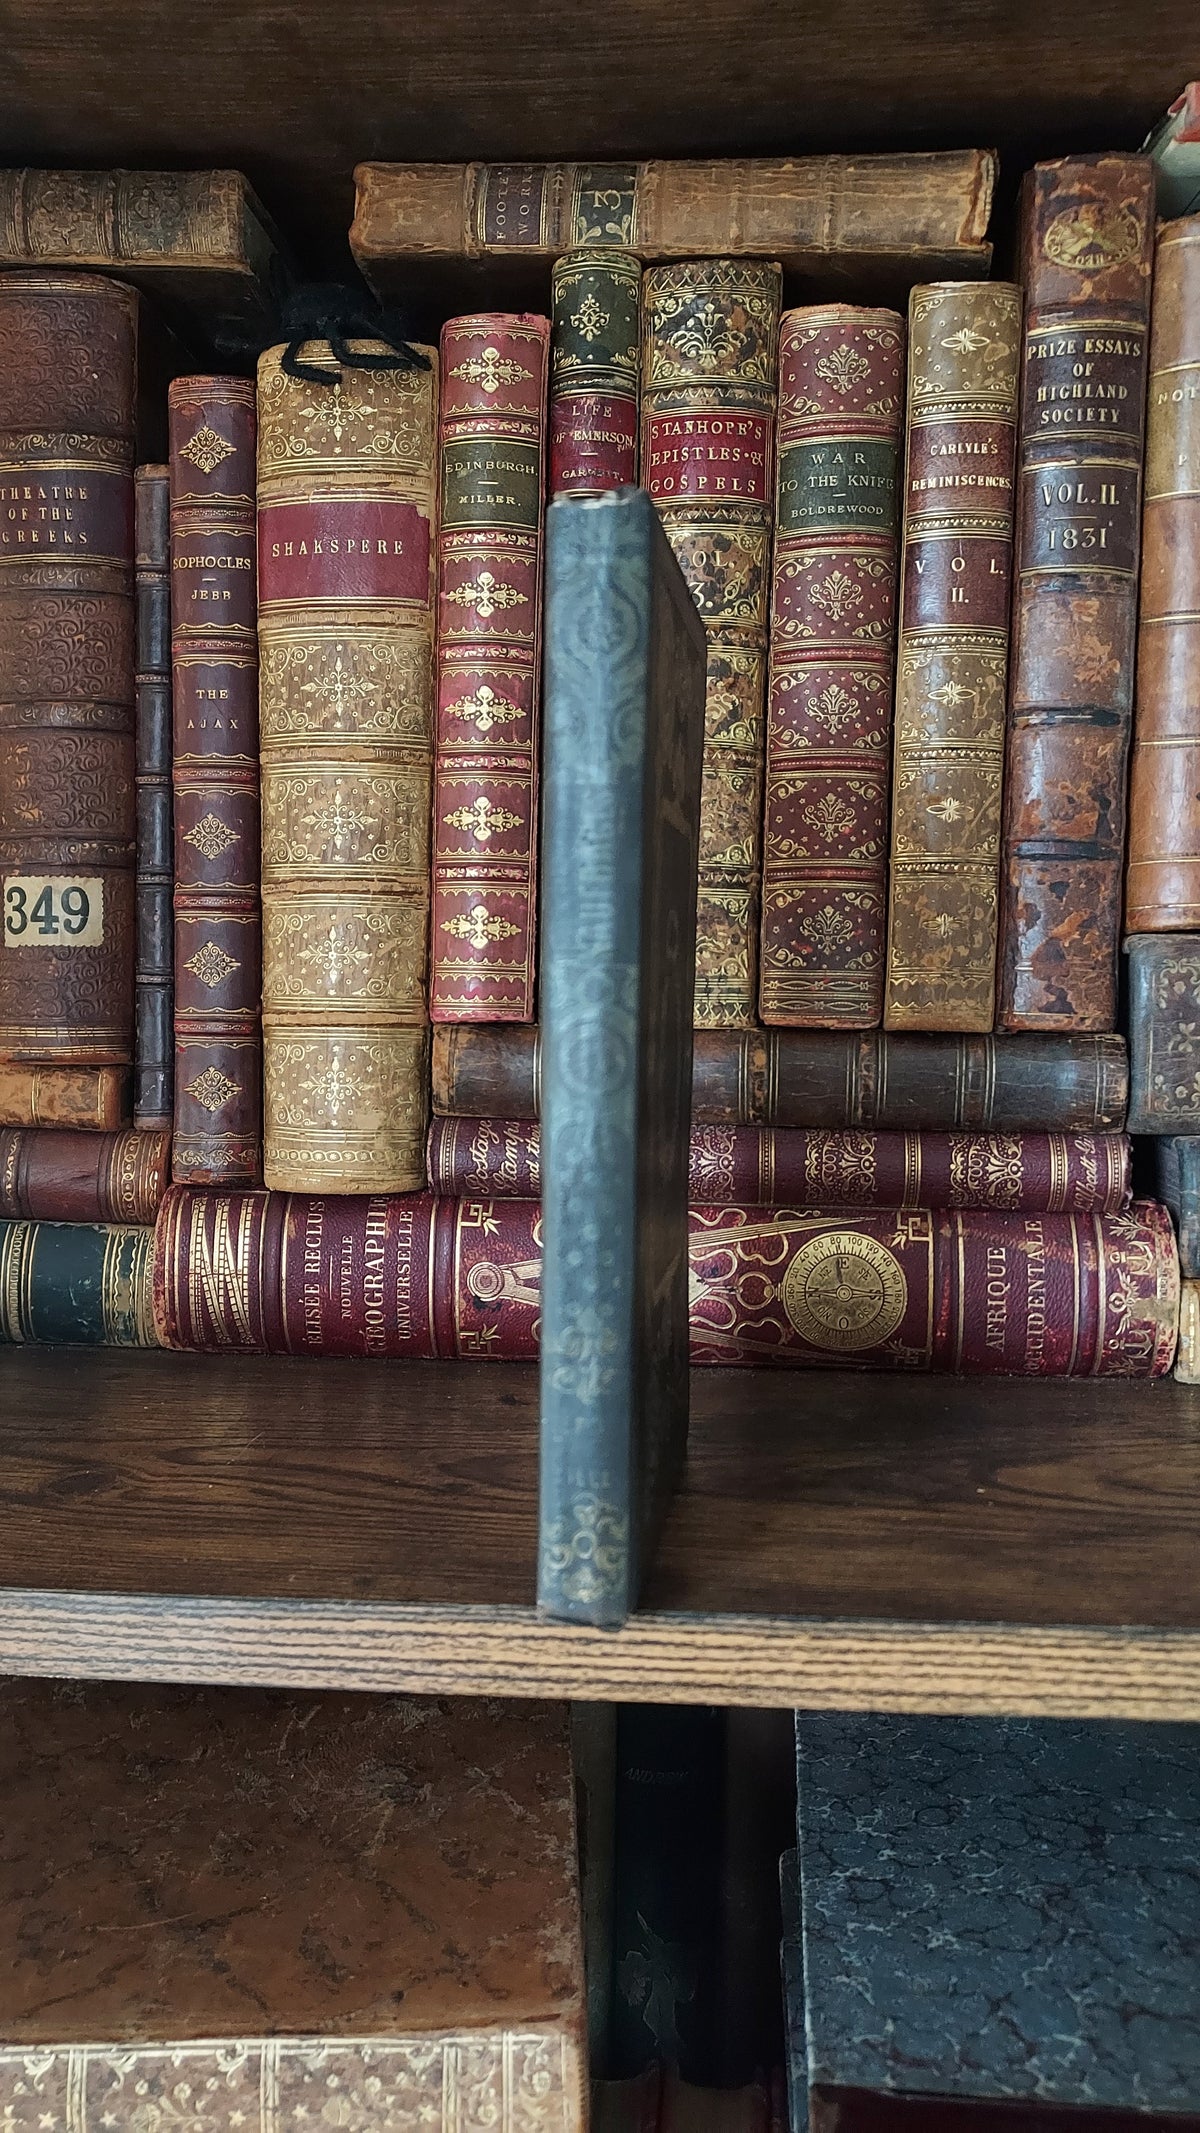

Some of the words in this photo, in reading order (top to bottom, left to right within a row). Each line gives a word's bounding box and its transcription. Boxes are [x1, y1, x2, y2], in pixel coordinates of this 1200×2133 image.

[518, 166, 534, 236] WORKS
[1026, 339, 1077, 361] PRIZE
[1084, 338, 1142, 357] ESSAYS
[1072, 362, 1095, 377] OF
[1037, 384, 1129, 403] HIGHLAND
[572, 405, 612, 418] LIFE
[1040, 407, 1121, 425] SOCIETY
[651, 420, 763, 440] STANHOPE'S
[930, 438, 999, 456] CARLYLE'S
[811, 452, 866, 465] WAR
[445, 461, 539, 476] EDINBURGH.
[650, 475, 756, 493] GOSPELS
[780, 479, 799, 494] TO
[808, 475, 839, 488] THE
[848, 474, 894, 489] KNIFE
[912, 474, 1013, 492] REMINISCENCES.
[0, 486, 88, 500] THEATRE
[458, 495, 522, 507] MILLER.
[8, 507, 28, 521] OF
[39, 507, 73, 521] THE
[791, 505, 884, 518] BOLDREWOOD
[2, 530, 88, 544] GREEKS
[1049, 527, 1107, 550] 1831
[271, 539, 403, 558] SHAKSPERE
[173, 556, 251, 570] SOPHOCLES
[692, 551, 735, 569] OL.
[191, 590, 231, 601] JEBB
[951, 587, 969, 603] II.
[195, 690, 229, 700] THE
[187, 719, 239, 730] AJAX
[6, 885, 90, 935] 349
[464, 1120, 500, 1194] Postage
[493, 1121, 524, 1194] Stamps
[304, 1201, 326, 1275] RECLUS
[341, 1235, 353, 1319] NOUVELLE
[397, 1211, 414, 1340] UNIVERSELLE
[986, 1247, 1010, 1352] AFRIQUE
[298, 1283, 323, 1345] ÉLISÉE
